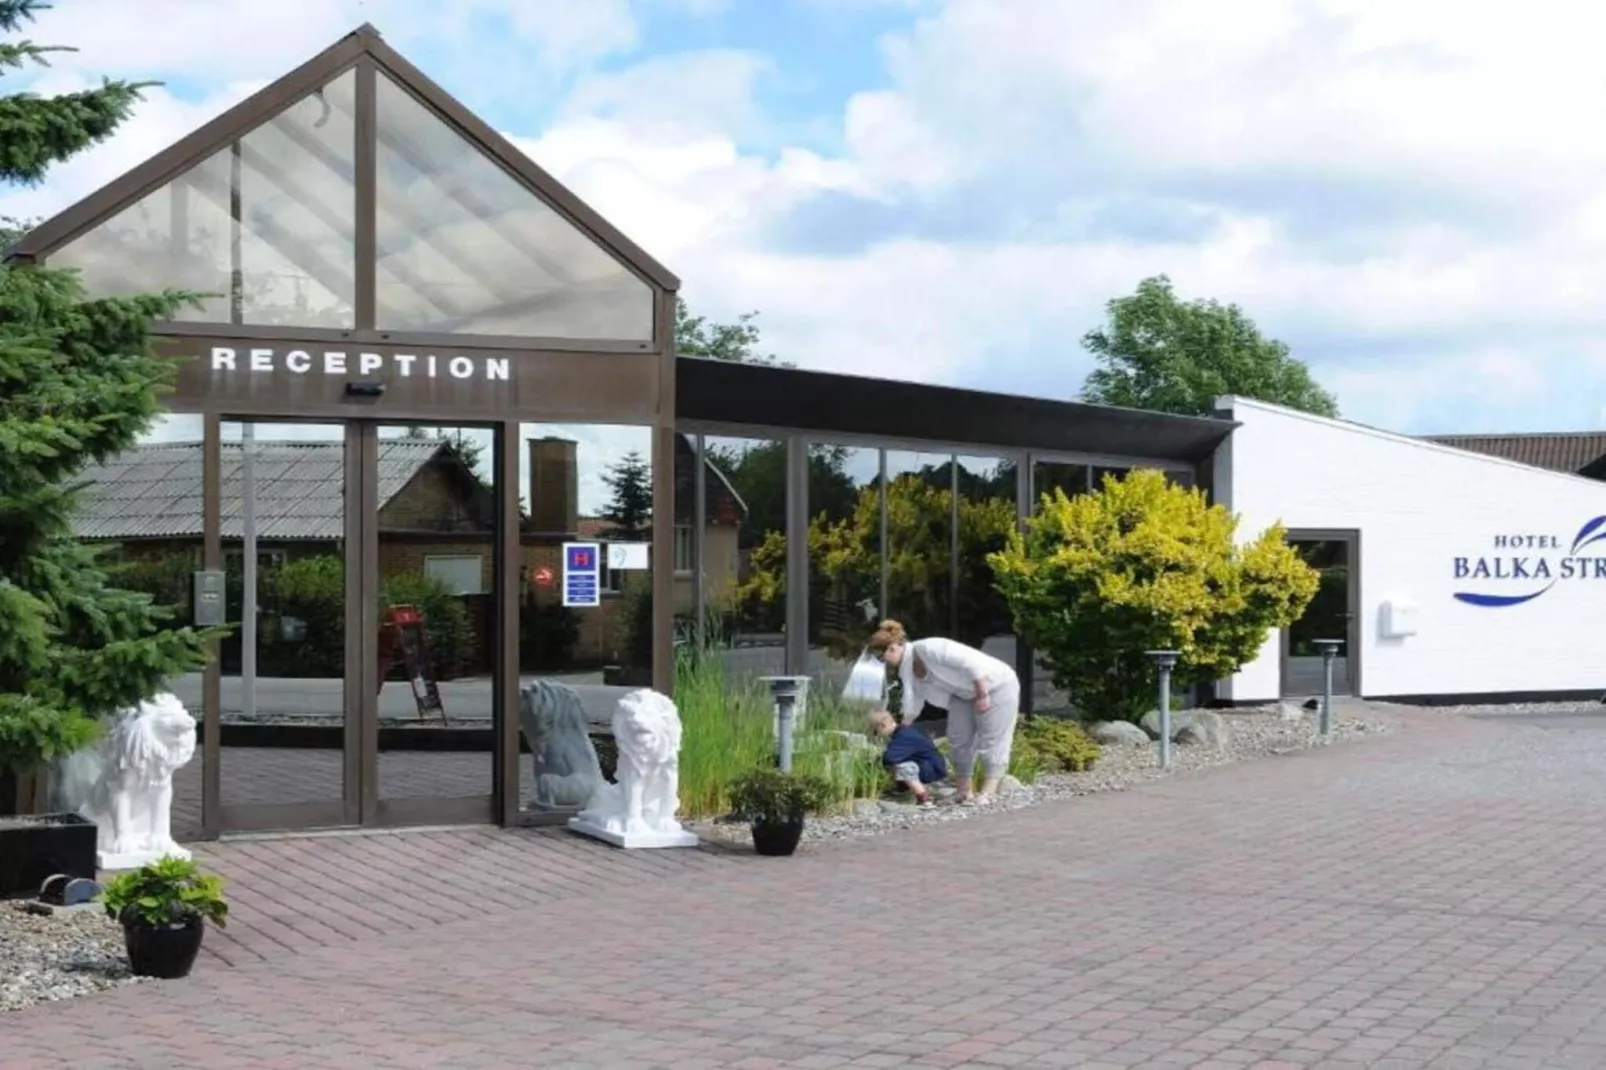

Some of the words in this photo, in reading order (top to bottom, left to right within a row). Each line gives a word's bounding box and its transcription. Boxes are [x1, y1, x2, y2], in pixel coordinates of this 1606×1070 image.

[210, 347, 511, 381] RECEPTION
[1494, 534, 1562, 549] HOTEL
[1453, 556, 1552, 579] BALKA
[1560, 556, 1606, 579] STR
